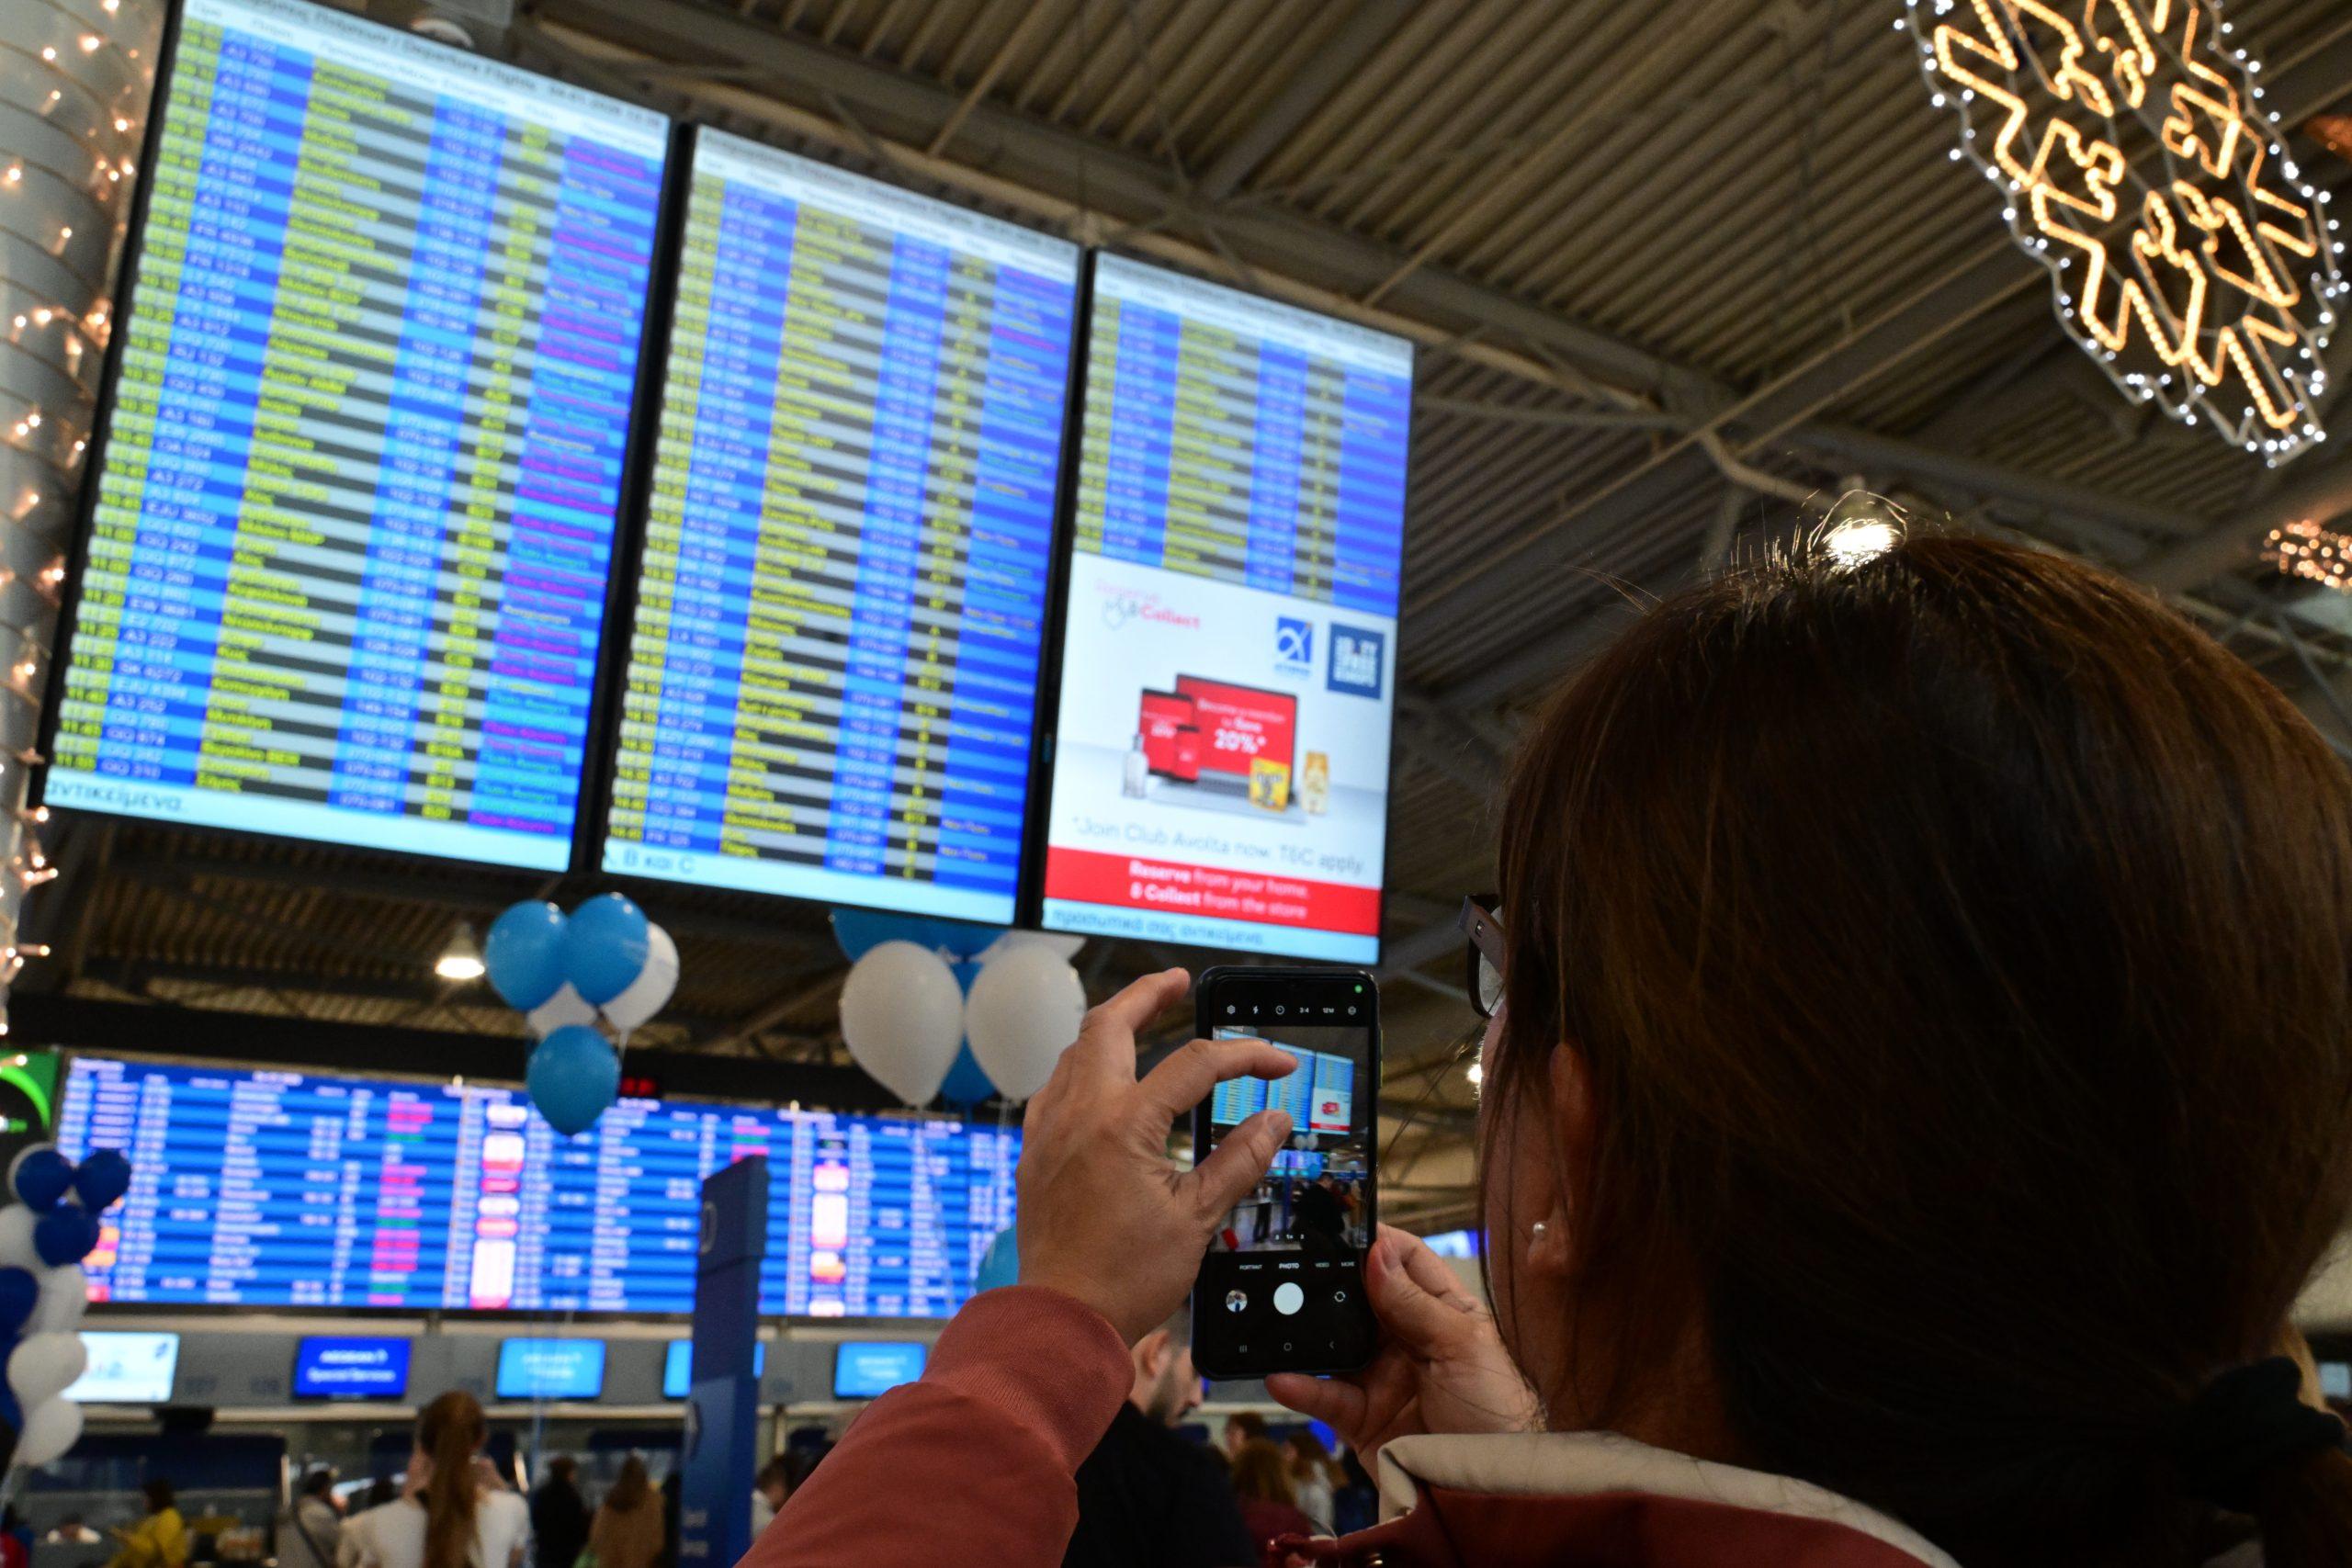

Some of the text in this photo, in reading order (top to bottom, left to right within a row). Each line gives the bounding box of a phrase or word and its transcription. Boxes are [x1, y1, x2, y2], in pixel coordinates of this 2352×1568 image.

[1139, 603, 1200, 631] Collect
[1125, 823, 1168, 843] Club
[1129, 859, 1193, 886] Reserve
[1193, 867, 1231, 888] from
[1231, 876, 1264, 895] your
[1144, 883, 1203, 908] Collect
[1203, 890, 1241, 912] from
[1241, 897, 1267, 916] the
[1268, 903, 1308, 920] store
[1278, 1262, 1300, 1270] PHOTO
